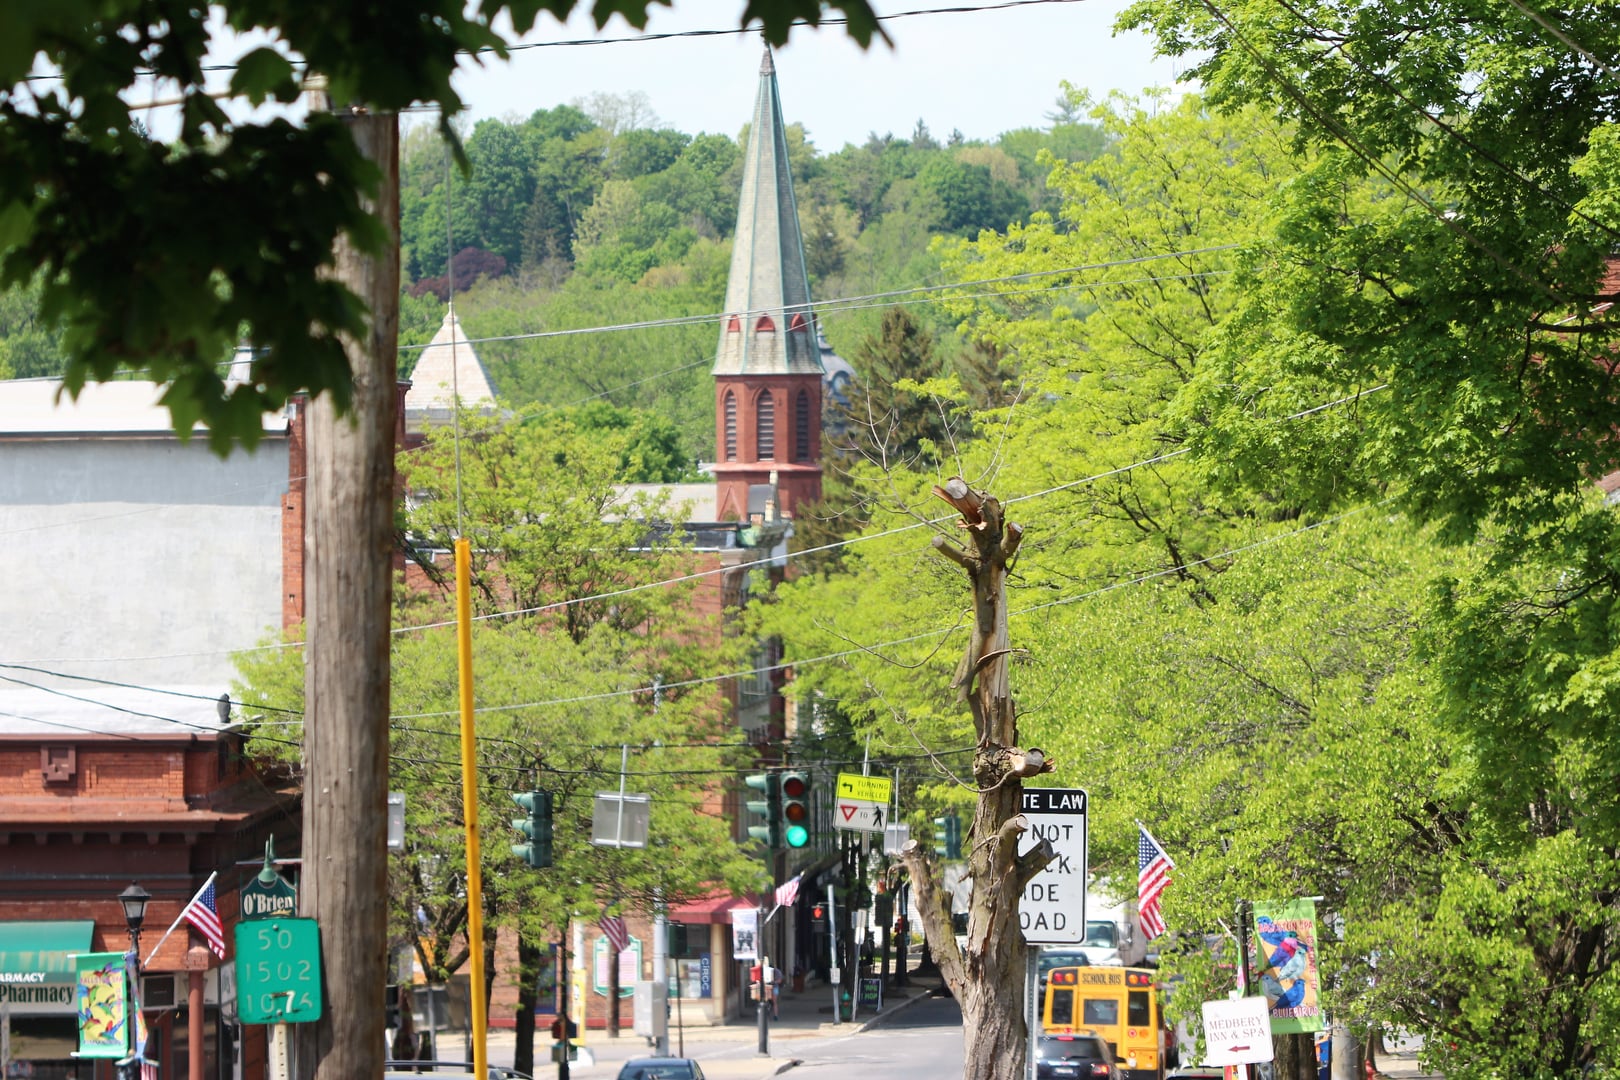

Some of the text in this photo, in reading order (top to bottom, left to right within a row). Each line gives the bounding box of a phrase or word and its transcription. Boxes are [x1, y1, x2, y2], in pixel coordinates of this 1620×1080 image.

[857, 780, 888, 790] TURNING
[857, 790, 887, 799] VEHICLES
[1049, 794, 1084, 810] LAW
[860, 811, 868, 819] TO
[1032, 824, 1073, 843] NOT
[243, 892, 294, 915] O'Brien
[1019, 911, 1067, 931] OAD
[257, 928, 292, 950] 50
[0, 972, 46, 983] ARMACY
[246, 959, 311, 982] 1502
[1082, 973, 1121, 985] SCHOOL BUS
[1209, 1014, 1263, 1031] MEDBERY
[1209, 1027, 1265, 1042] INN & SPA
